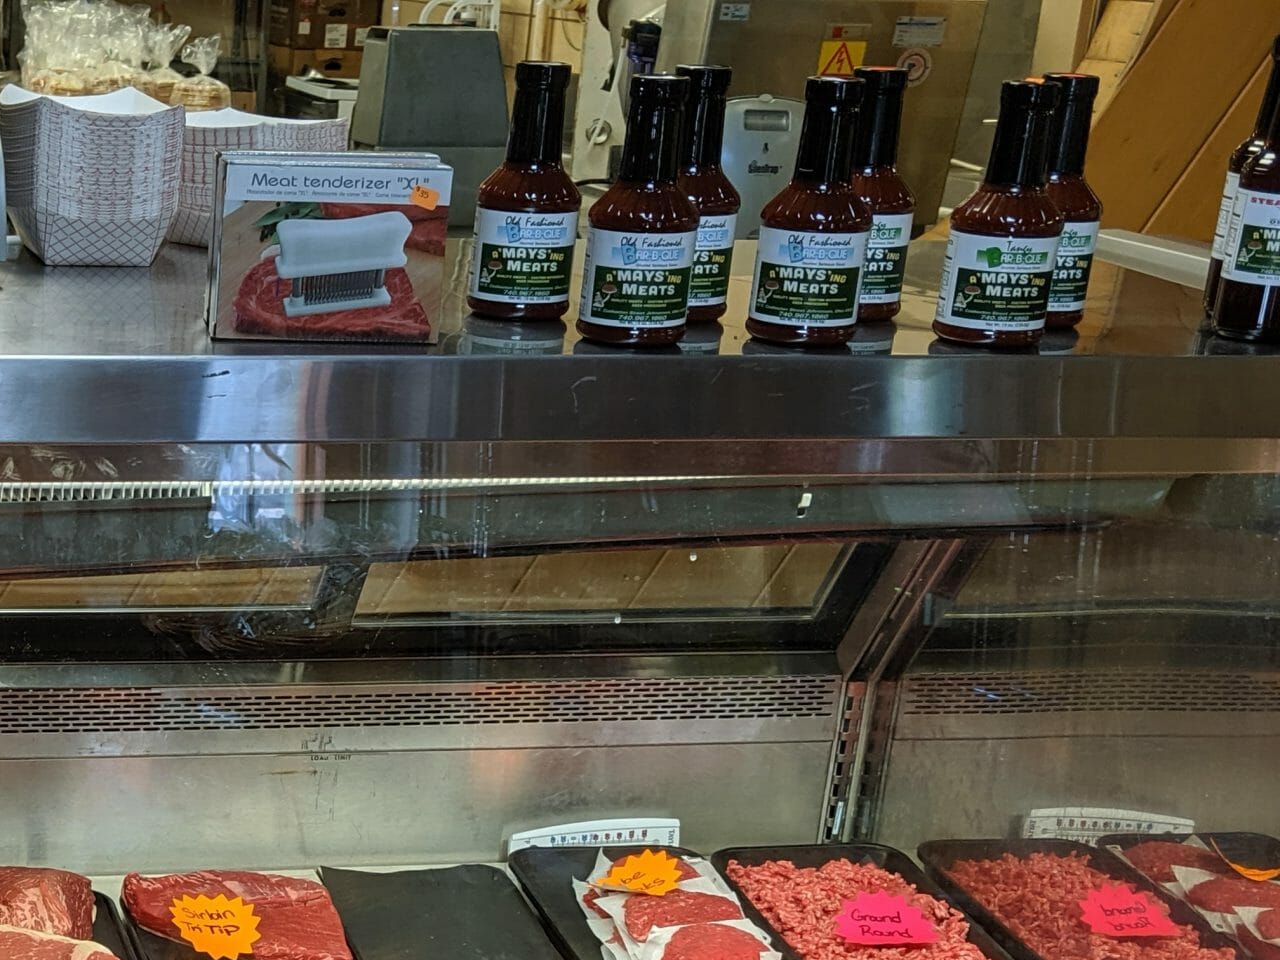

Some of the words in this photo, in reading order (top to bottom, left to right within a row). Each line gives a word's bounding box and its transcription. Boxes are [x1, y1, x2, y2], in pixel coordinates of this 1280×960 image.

[251, 173, 300, 187] Meat
[303, 176, 392, 190] tenderizer
[505, 216, 521, 225] Old
[525, 217, 565, 226] Fashioned
[506, 224, 561, 243] BAR-B-QUE
[621, 236, 637, 246] Old
[642, 236, 683, 247] Fashioned
[788, 235, 804, 245] Old
[809, 235, 853, 246] Fashioned
[1006, 241, 1032, 252] Tangy
[621, 245, 680, 265] BAR-B-QUE
[789, 243, 848, 263] BAR-B-QUE
[506, 260, 558, 272] MEATS
[622, 283, 675, 296] MEATS
[782, 281, 838, 295] MEATS
[985, 285, 1039, 298] MEATS
[182, 907, 235, 920] Sirloin
[851, 909, 902, 923] Ground
[180, 920, 203, 933] Tri
[859, 924, 913, 938] Round
